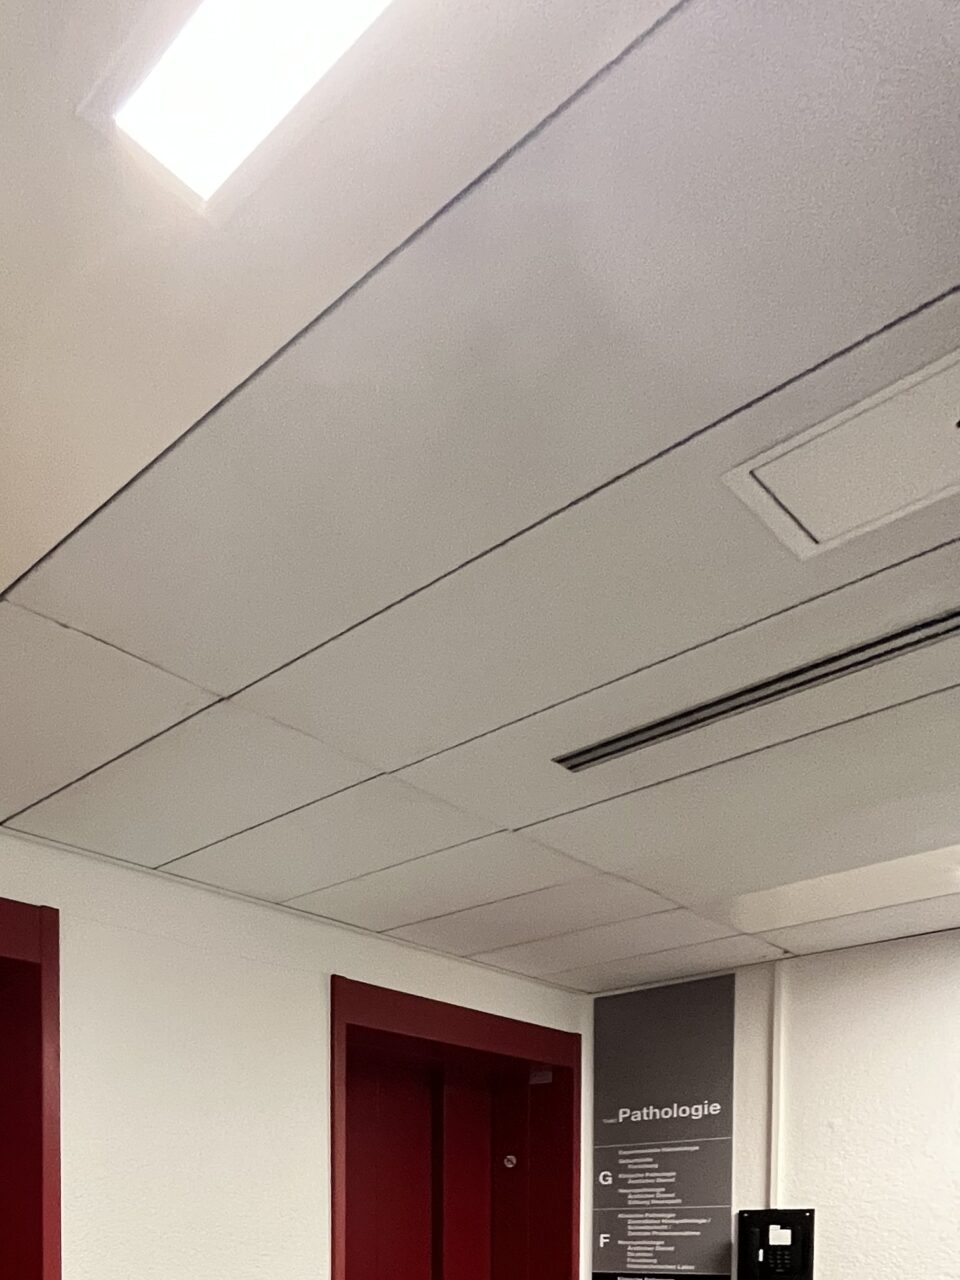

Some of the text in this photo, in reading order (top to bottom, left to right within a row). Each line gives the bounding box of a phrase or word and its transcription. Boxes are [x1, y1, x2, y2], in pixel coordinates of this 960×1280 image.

[619, 1101, 721, 1122] Pathologie
[599, 1171, 612, 1184] G
[600, 1234, 610, 1247] F
